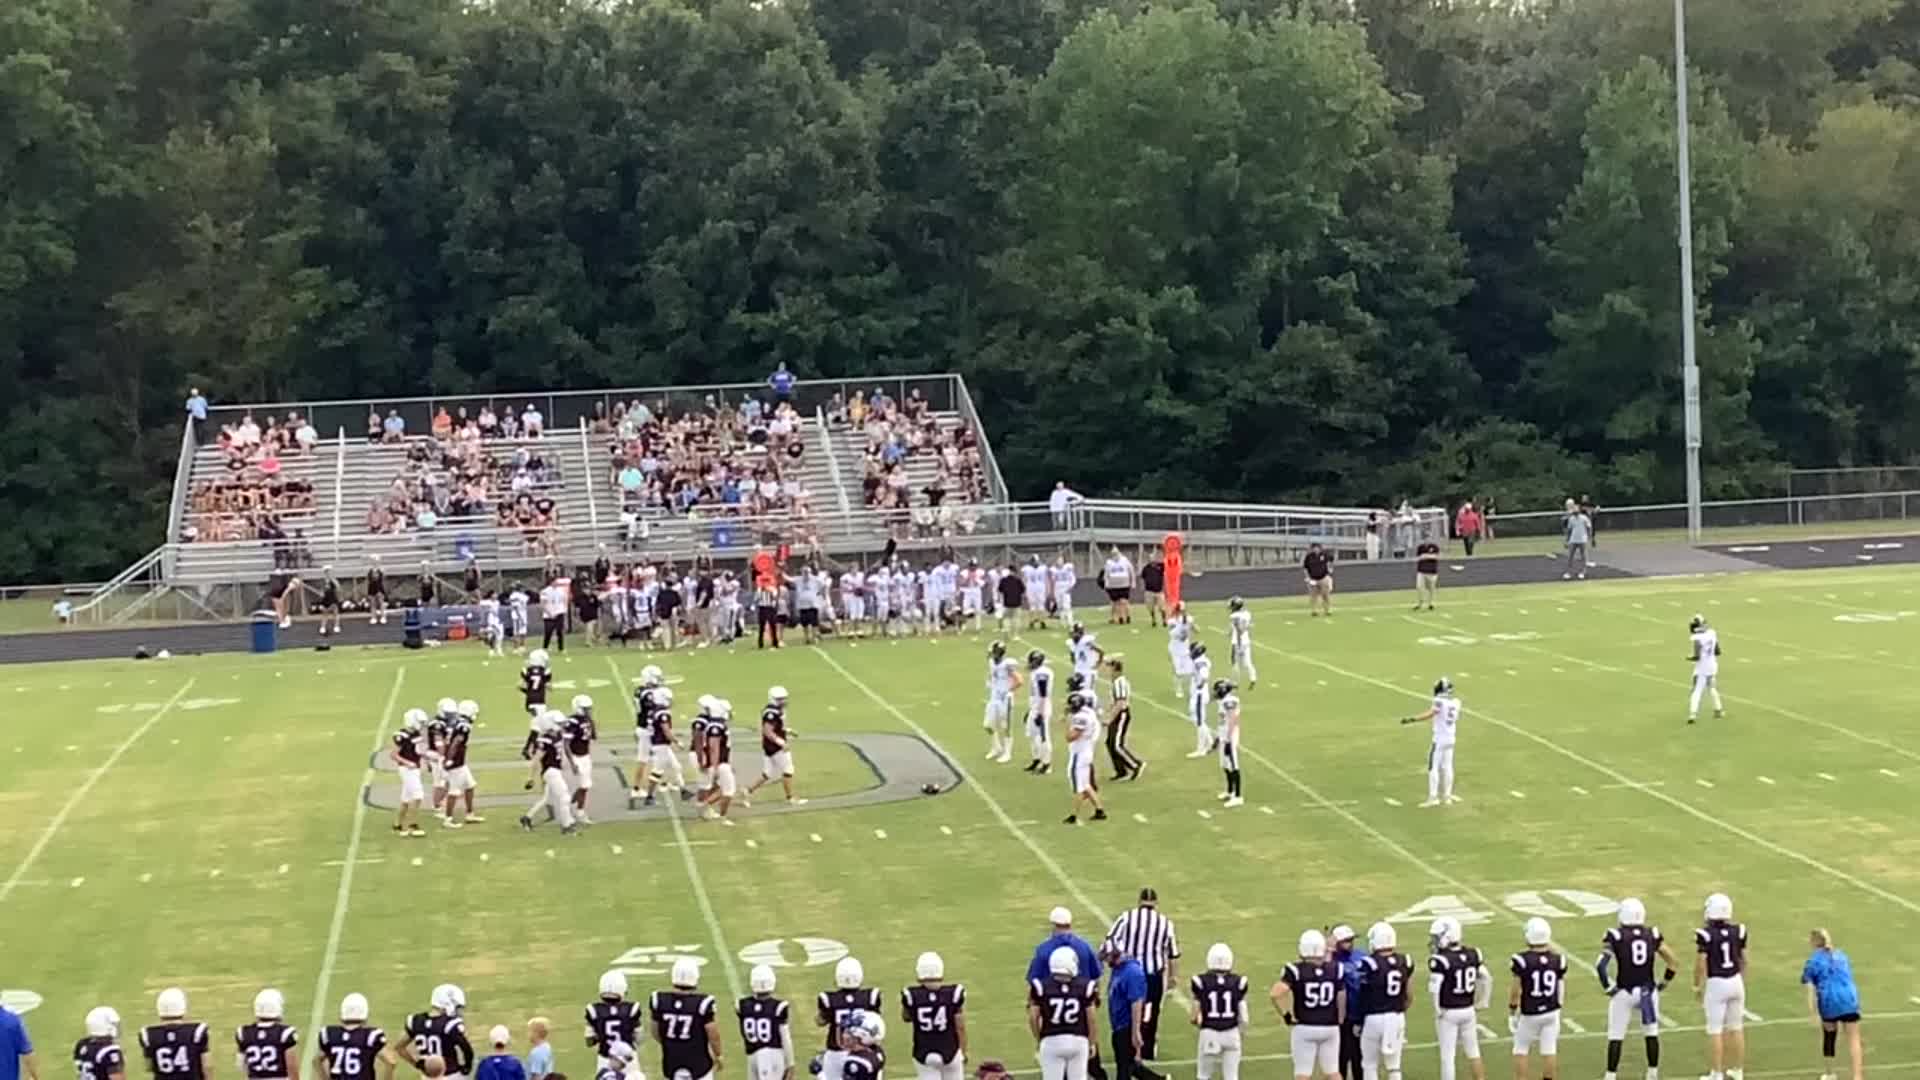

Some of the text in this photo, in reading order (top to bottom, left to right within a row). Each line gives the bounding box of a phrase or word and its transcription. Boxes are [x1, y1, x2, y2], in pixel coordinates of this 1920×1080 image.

[530, 675, 541, 690] 7
[609, 938, 849, 974] 50
[1631, 940, 1648, 966] 8
[1721, 943, 1734, 968] 1
[1386, 970, 1402, 996] 6
[1454, 967, 1477, 994] 18
[1530, 970, 1556, 997] 19
[1207, 990, 1234, 1018] 11
[1304, 981, 1335, 1008] 50
[916, 1006, 947, 1032] 54
[1049, 997, 1080, 1024] 72
[604, 1020, 621, 1042] 5
[662, 1013, 693, 1039] 77
[245, 1045, 279, 1071] 22
[414, 1034, 442, 1057] 20
[156, 1045, 190, 1073] 64
[330, 1046, 361, 1074] 76
